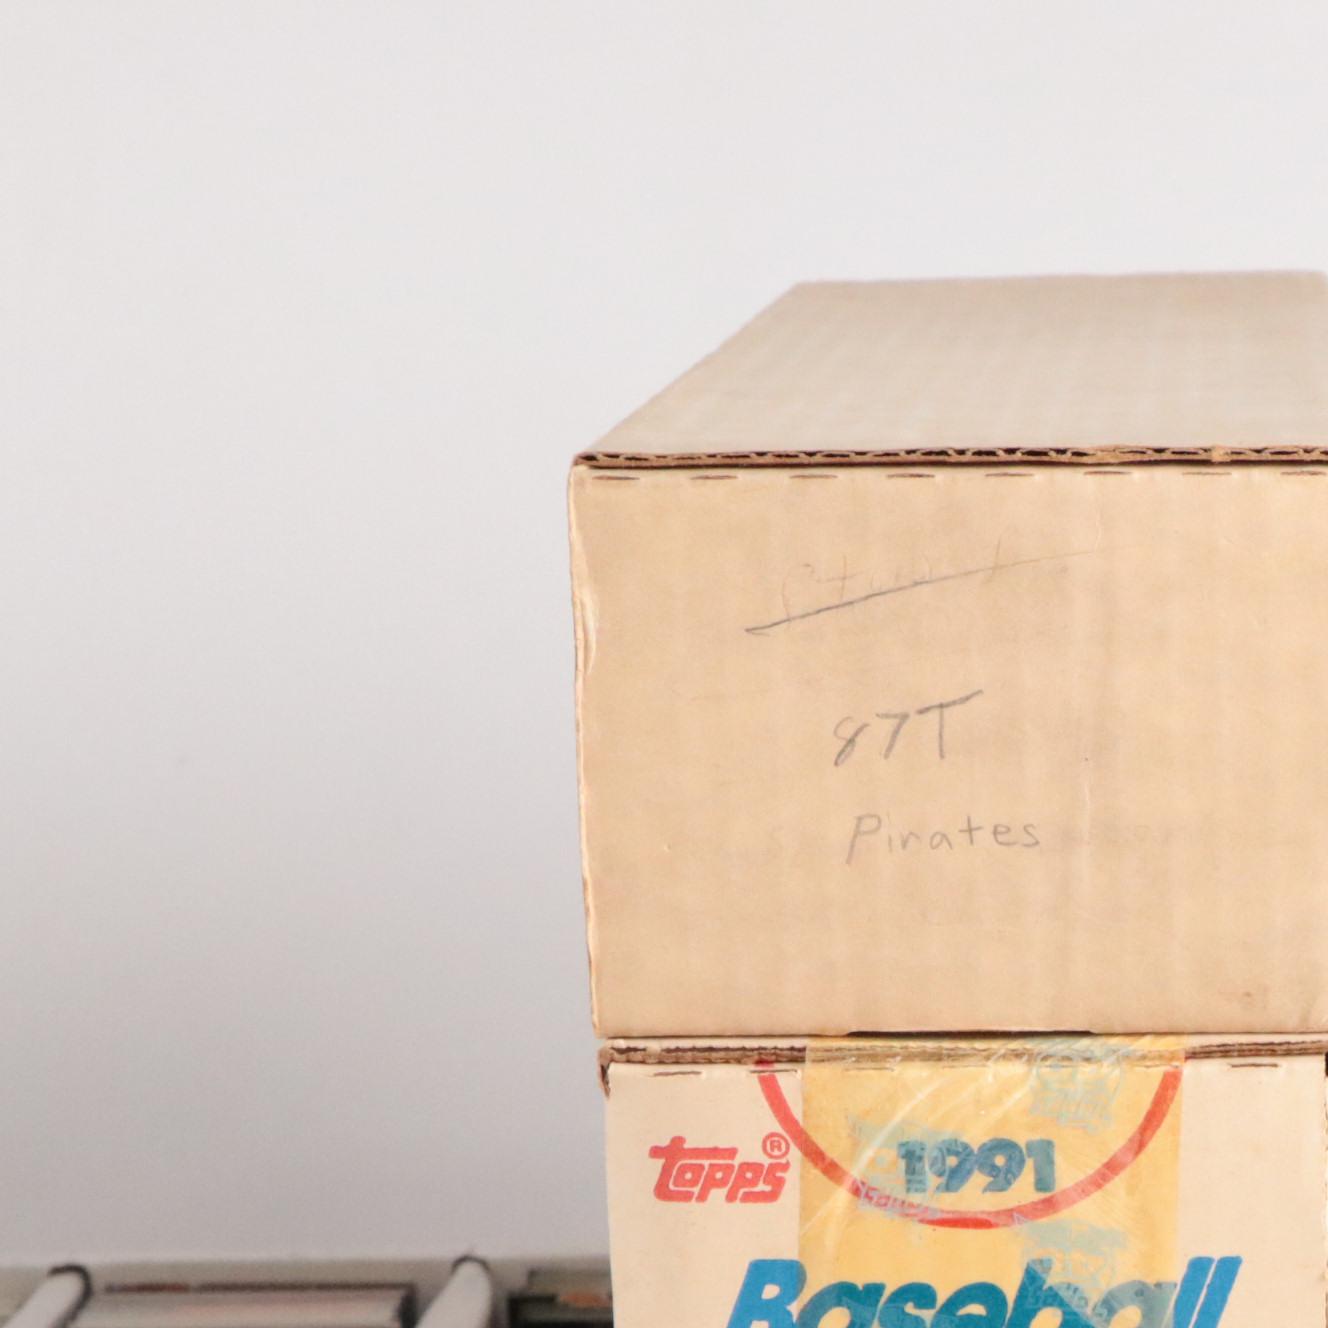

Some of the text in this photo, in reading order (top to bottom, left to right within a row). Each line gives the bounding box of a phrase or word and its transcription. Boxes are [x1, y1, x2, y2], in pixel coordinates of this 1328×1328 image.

[832, 688, 985, 767] 87T
[844, 812, 1042, 864] Pirates
[896, 1137, 1057, 1194] 1991
